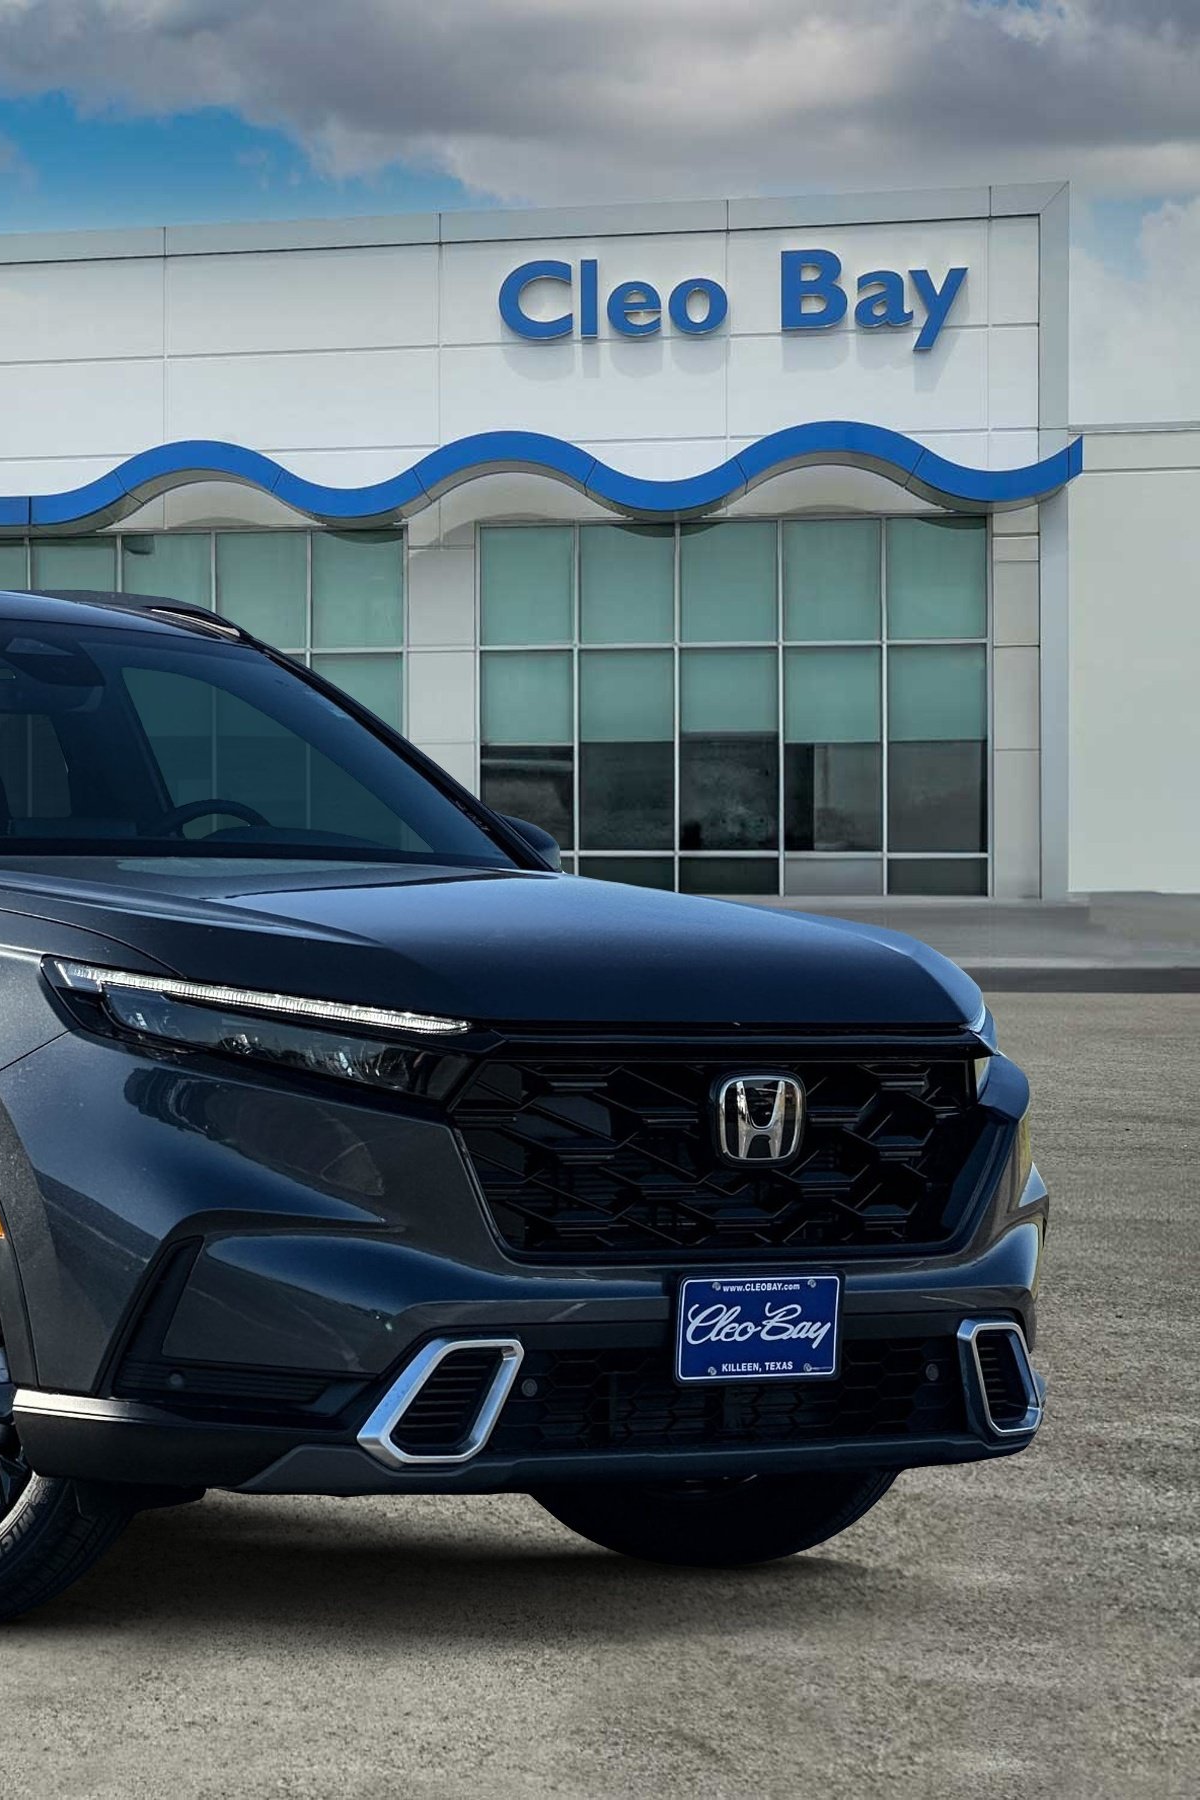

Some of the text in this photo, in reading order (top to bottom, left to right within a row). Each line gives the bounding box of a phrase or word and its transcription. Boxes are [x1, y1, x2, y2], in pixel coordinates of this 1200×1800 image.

[499, 248, 968, 351] Cleo Bay
[722, 1282, 800, 1293] www.CLEOBAY.com
[686, 1302, 831, 1349] Cleo Bay
[721, 1361, 793, 1372] KILLEEN, TEXAS
